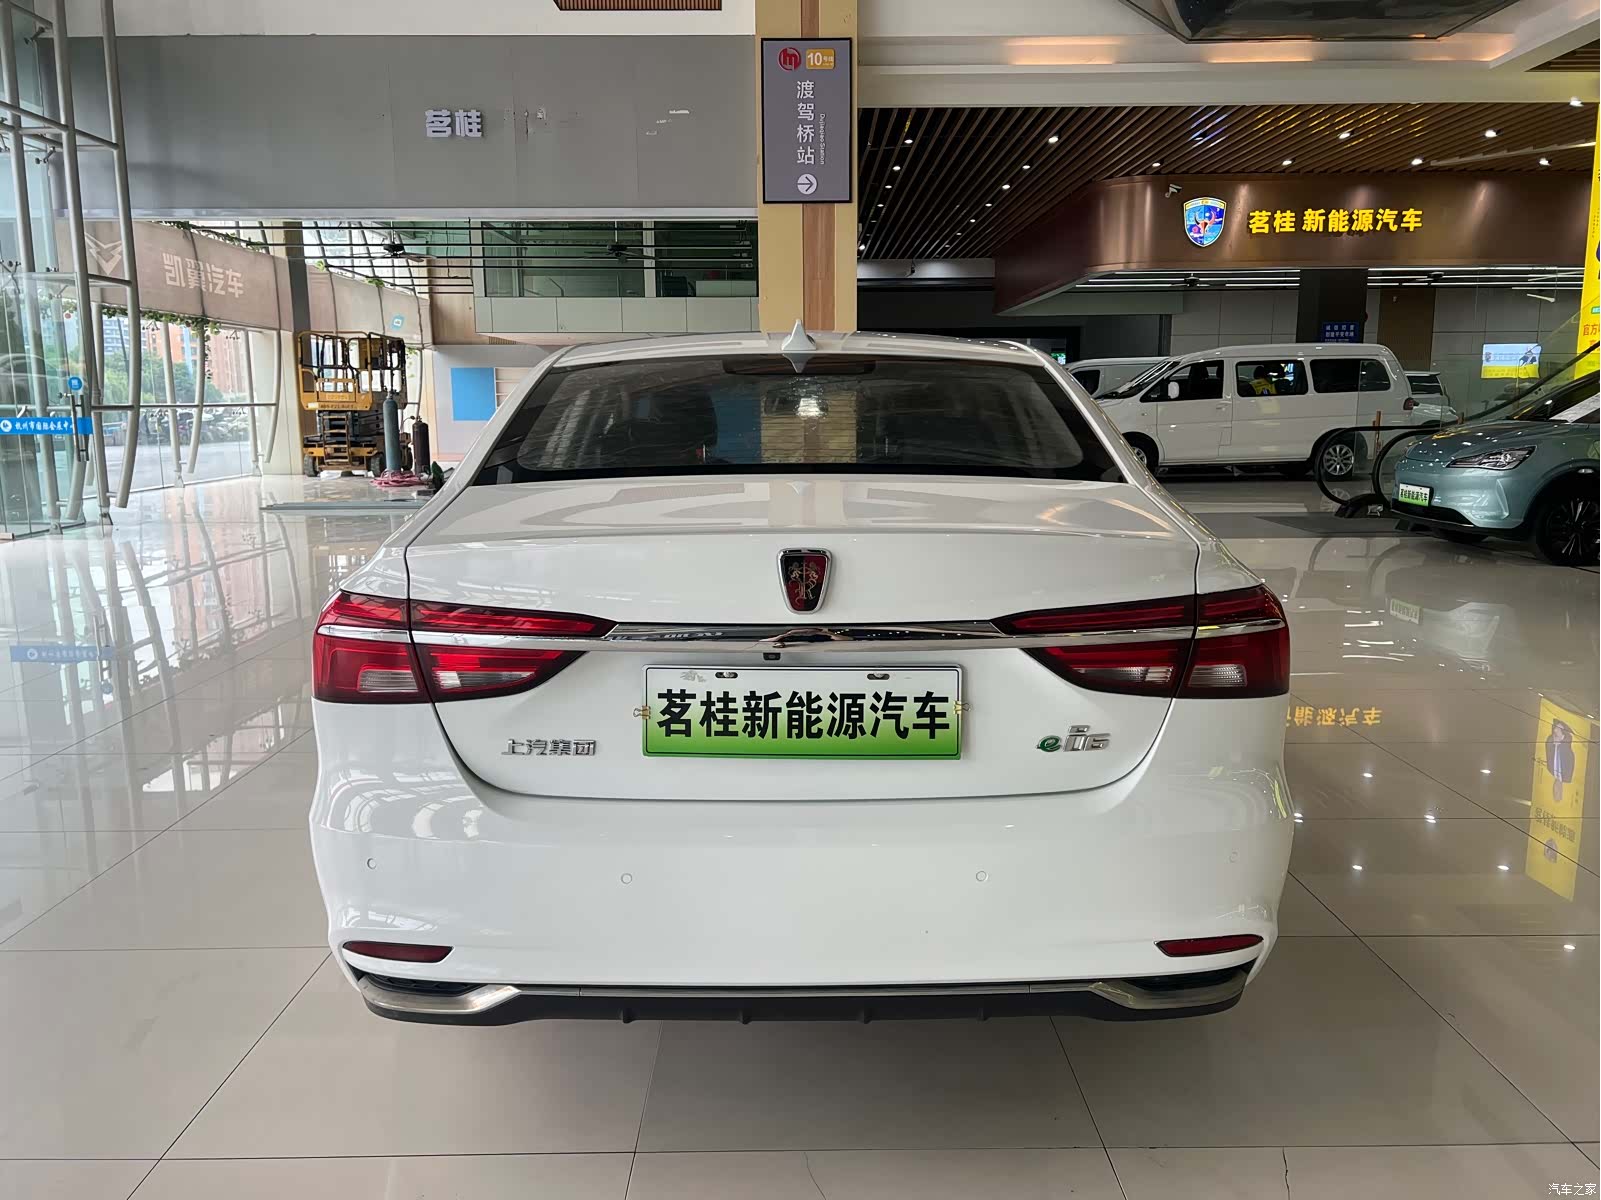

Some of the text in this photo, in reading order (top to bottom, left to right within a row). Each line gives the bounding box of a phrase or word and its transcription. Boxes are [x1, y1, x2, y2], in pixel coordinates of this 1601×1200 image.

[425, 109, 482, 137] 茗桂
[796, 80, 815, 165] 渡驾桥站
[1248, 208, 1423, 234] 茗桂 新能源汽车
[162, 252, 244, 298] 凯翼汽车
[657, 688, 950, 740] 茗桂新能源汽车
[501, 738, 597, 756] 上汽集团
